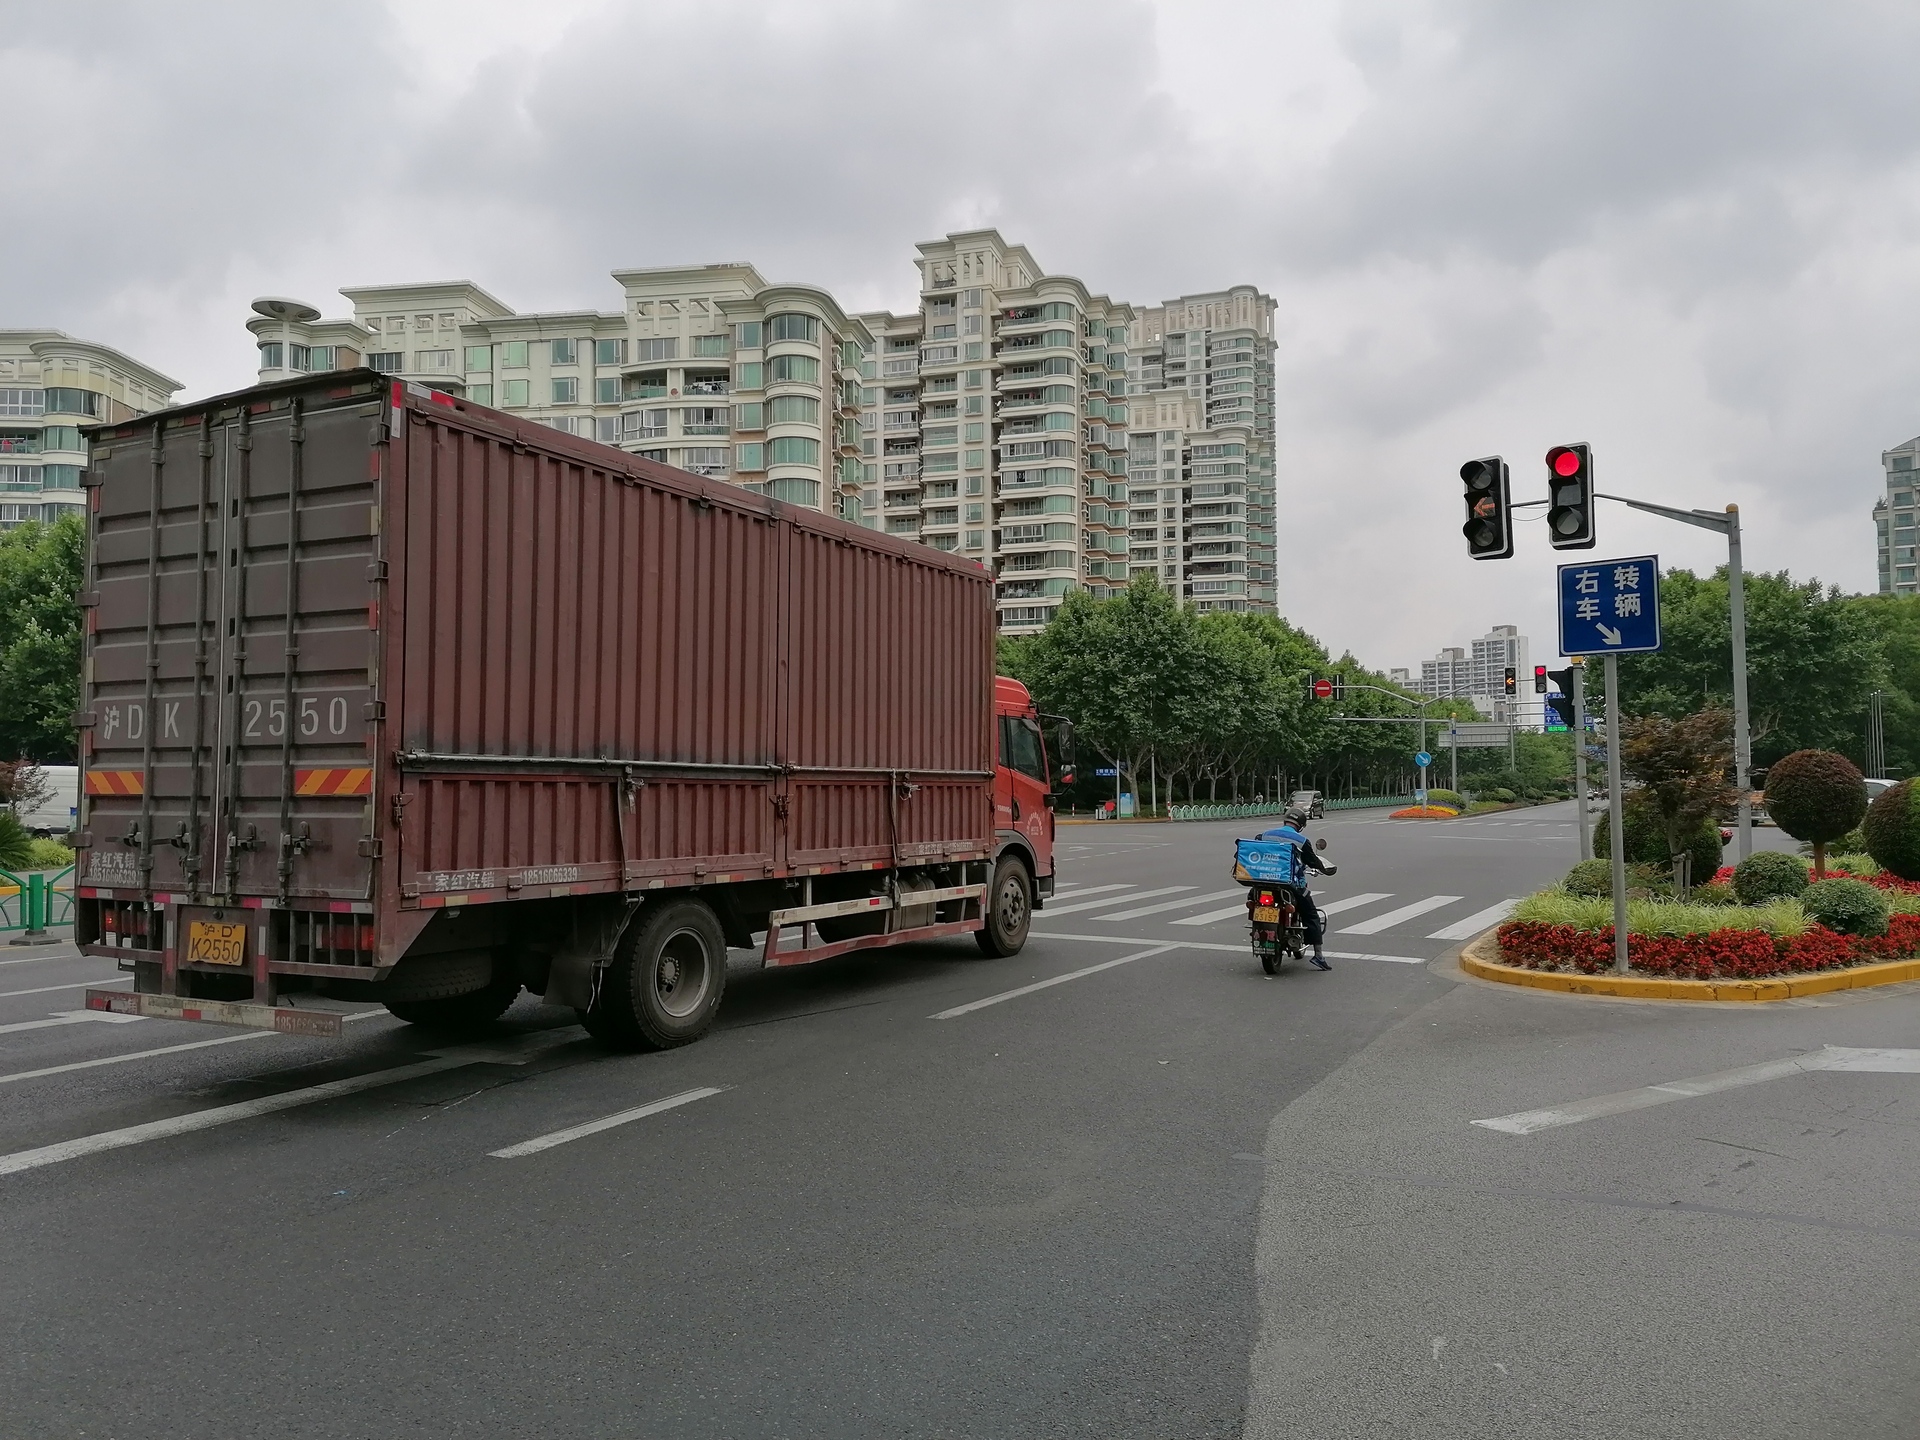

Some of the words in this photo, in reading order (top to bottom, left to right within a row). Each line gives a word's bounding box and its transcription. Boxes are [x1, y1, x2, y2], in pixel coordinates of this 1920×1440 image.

[1575, 565, 1640, 594] 右转
[1575, 592, 1642, 621] 车辆
[435, 871, 495, 892] 家红汽销
[1254, 913, 1278, 922] R3157
[190, 937, 241, 963] K2550
